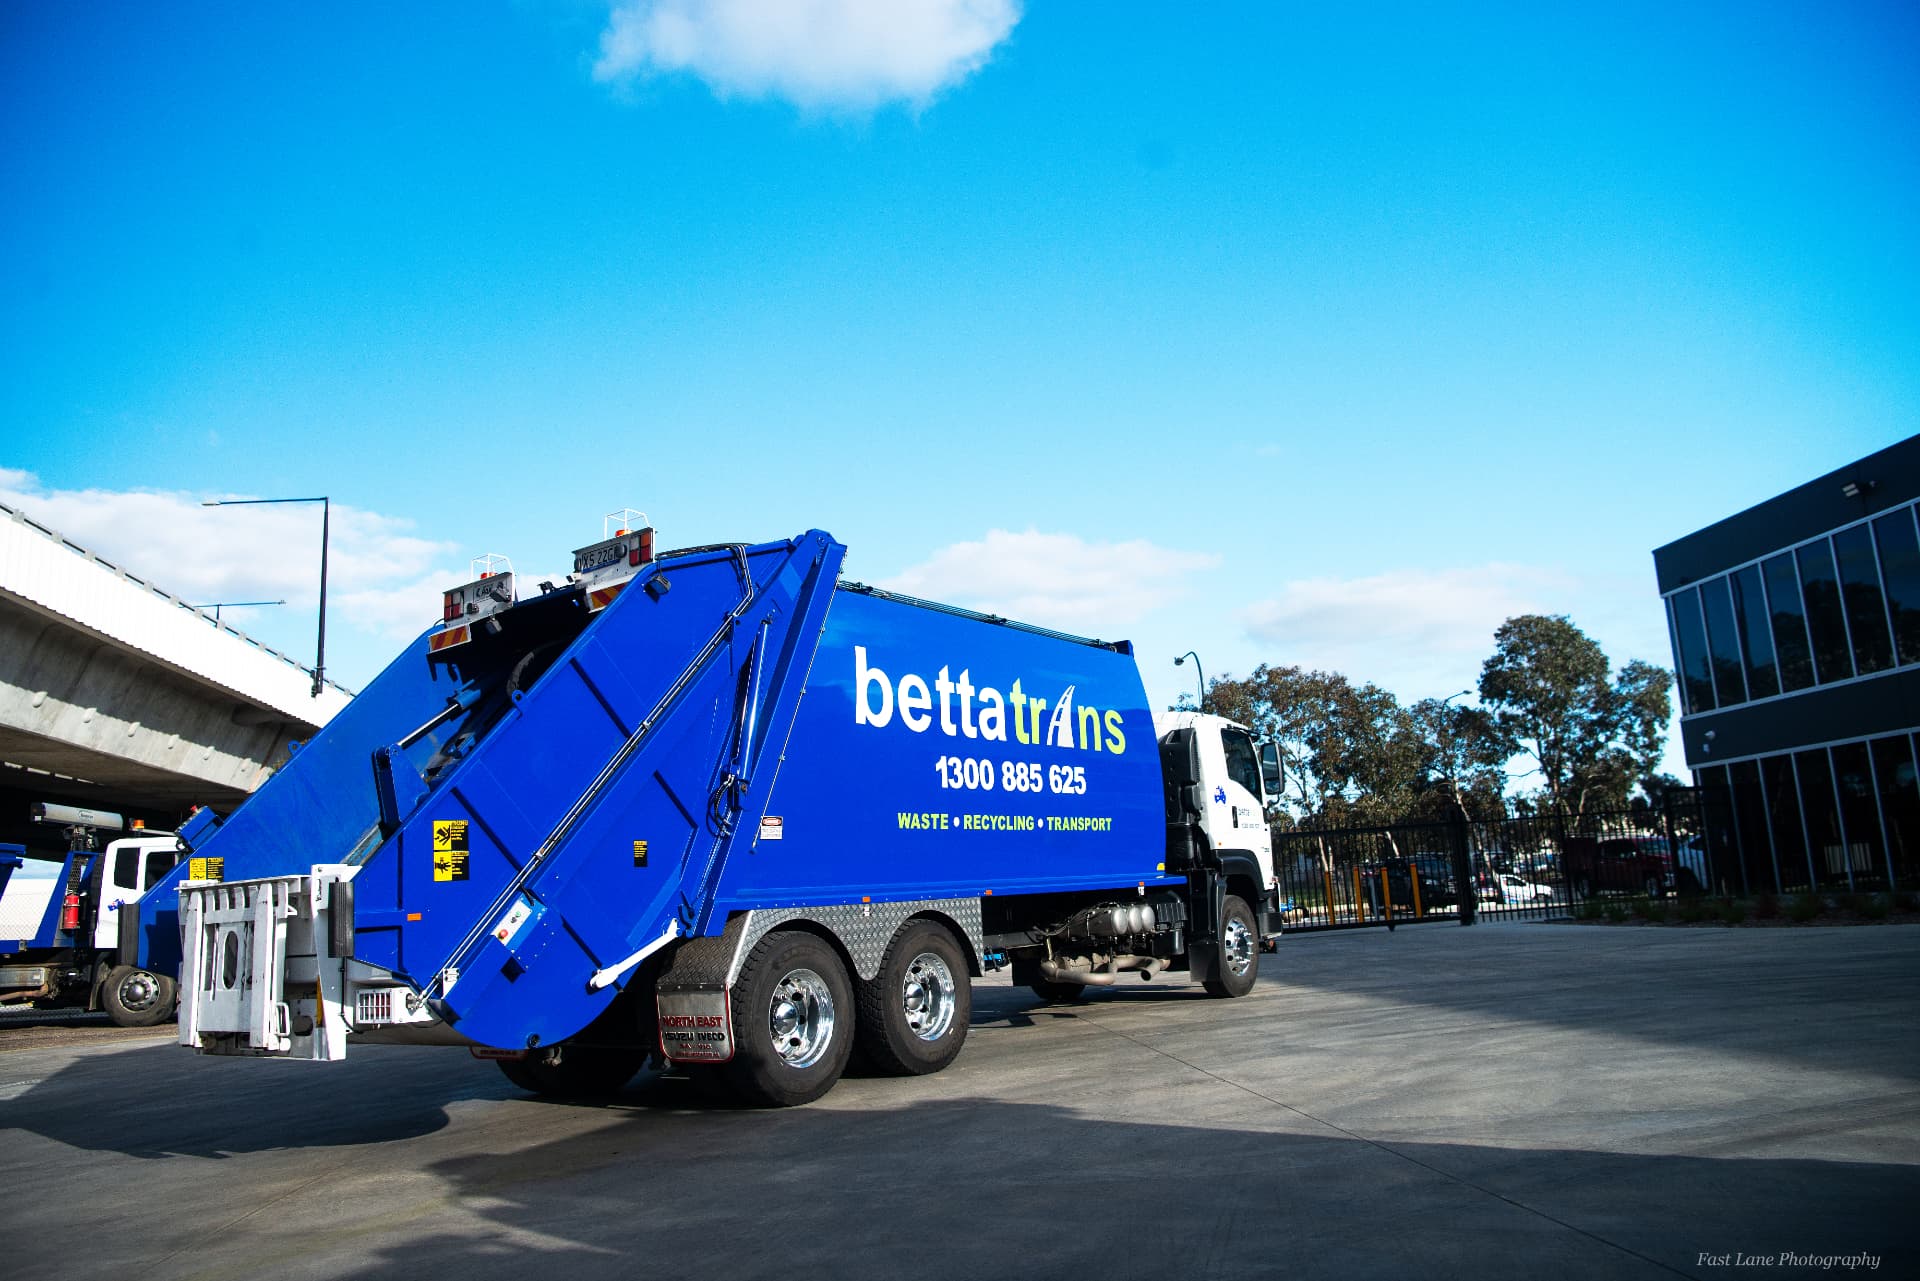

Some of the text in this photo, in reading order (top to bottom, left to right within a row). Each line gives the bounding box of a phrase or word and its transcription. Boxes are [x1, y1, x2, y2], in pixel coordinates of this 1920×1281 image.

[598, 546, 620, 564] 22G
[854, 645, 1126, 755] bettatrans
[935, 755, 1087, 795] 1300 885 625
[897, 812, 1112, 831] WASTE RECYCLING TRANSPORT
[662, 1016, 723, 1028] NORTH EAST
[665, 1032, 725, 1041] ISUZU IVECO
